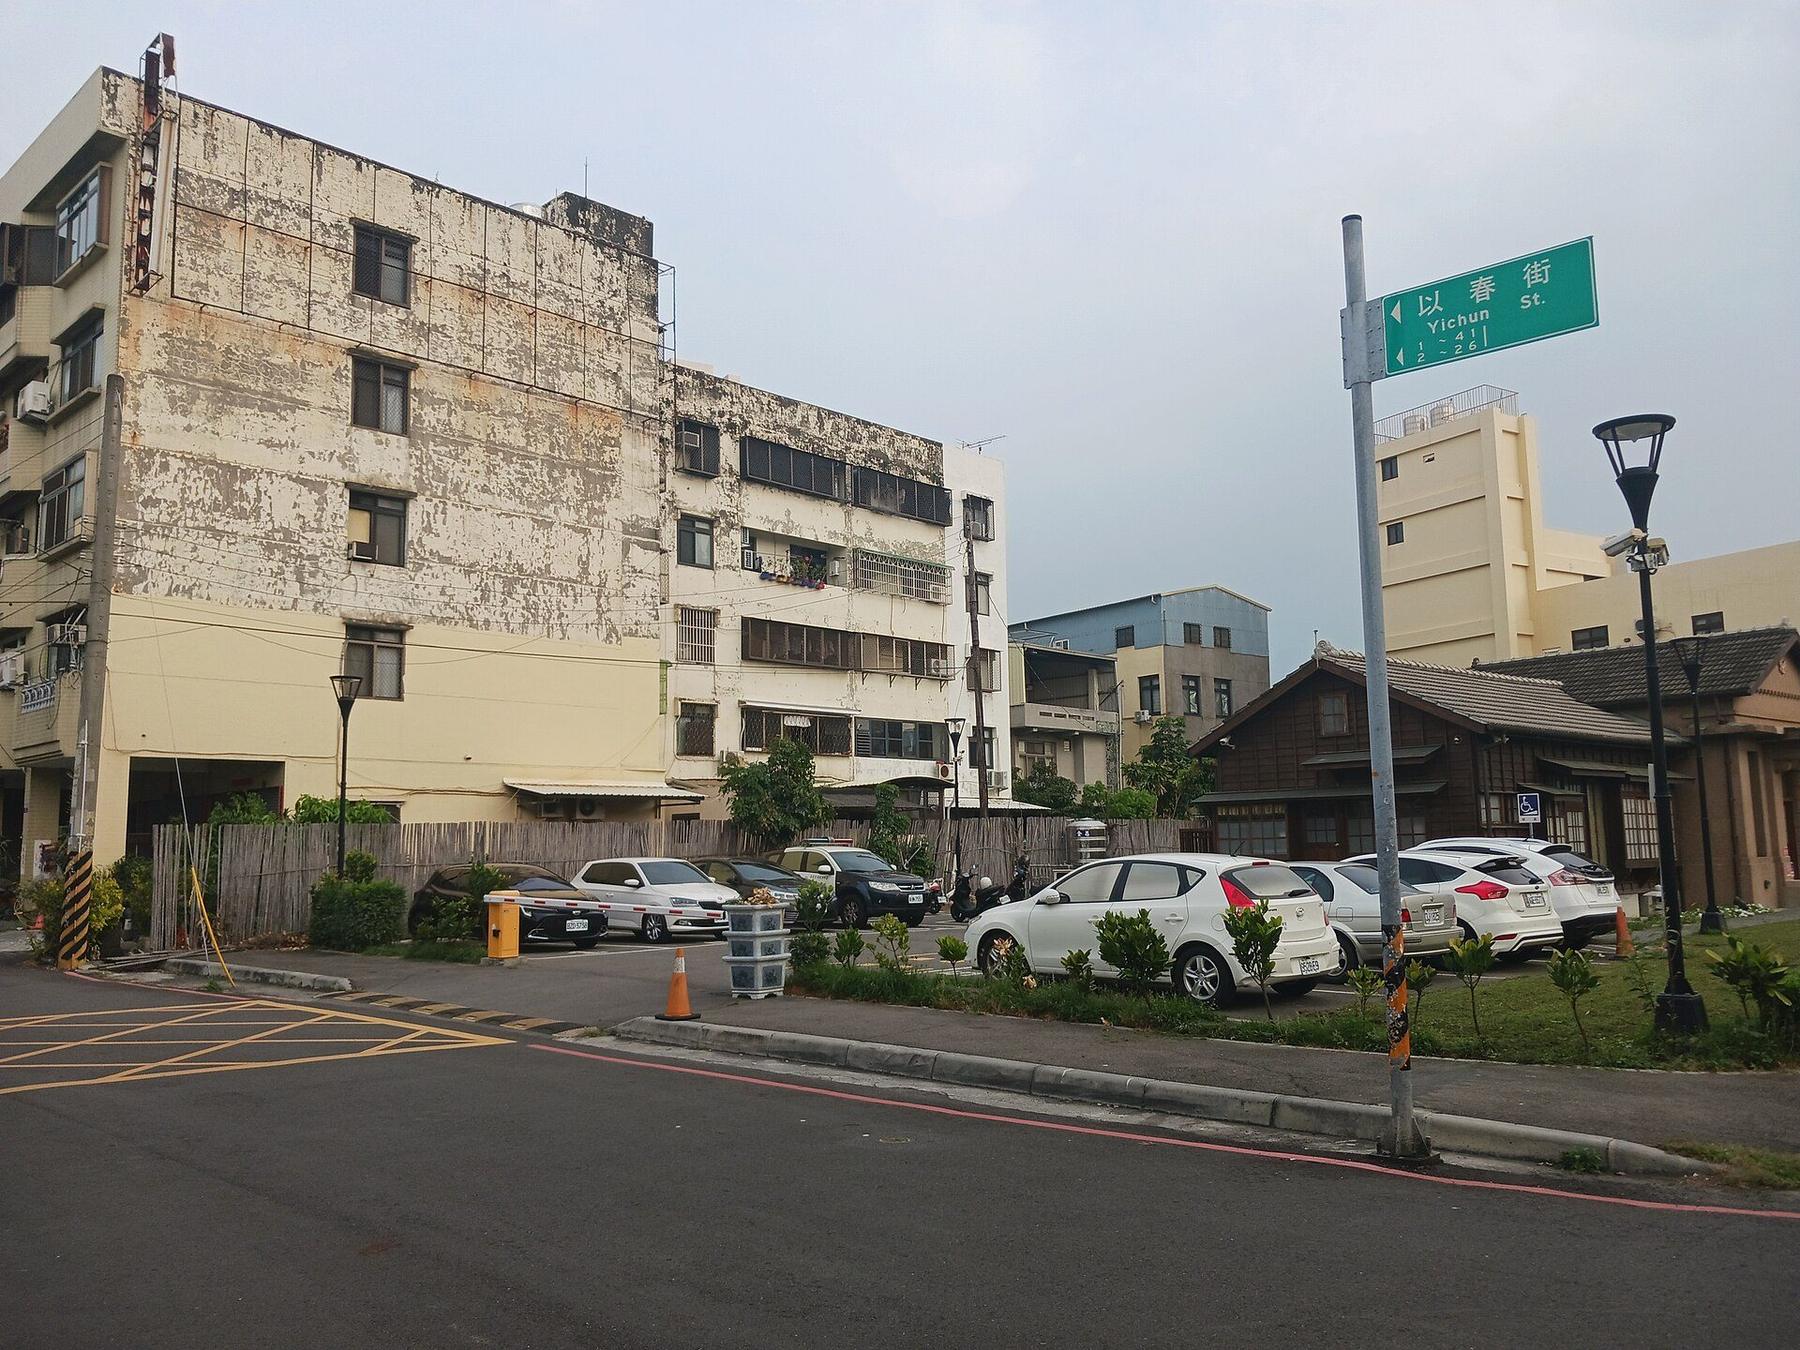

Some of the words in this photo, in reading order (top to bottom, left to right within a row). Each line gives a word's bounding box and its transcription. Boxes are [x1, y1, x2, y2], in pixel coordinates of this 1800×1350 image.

[1418, 258, 1551, 317] 以春街
[1427, 309, 1490, 334] Yichun
[1520, 292, 1546, 309] St.
